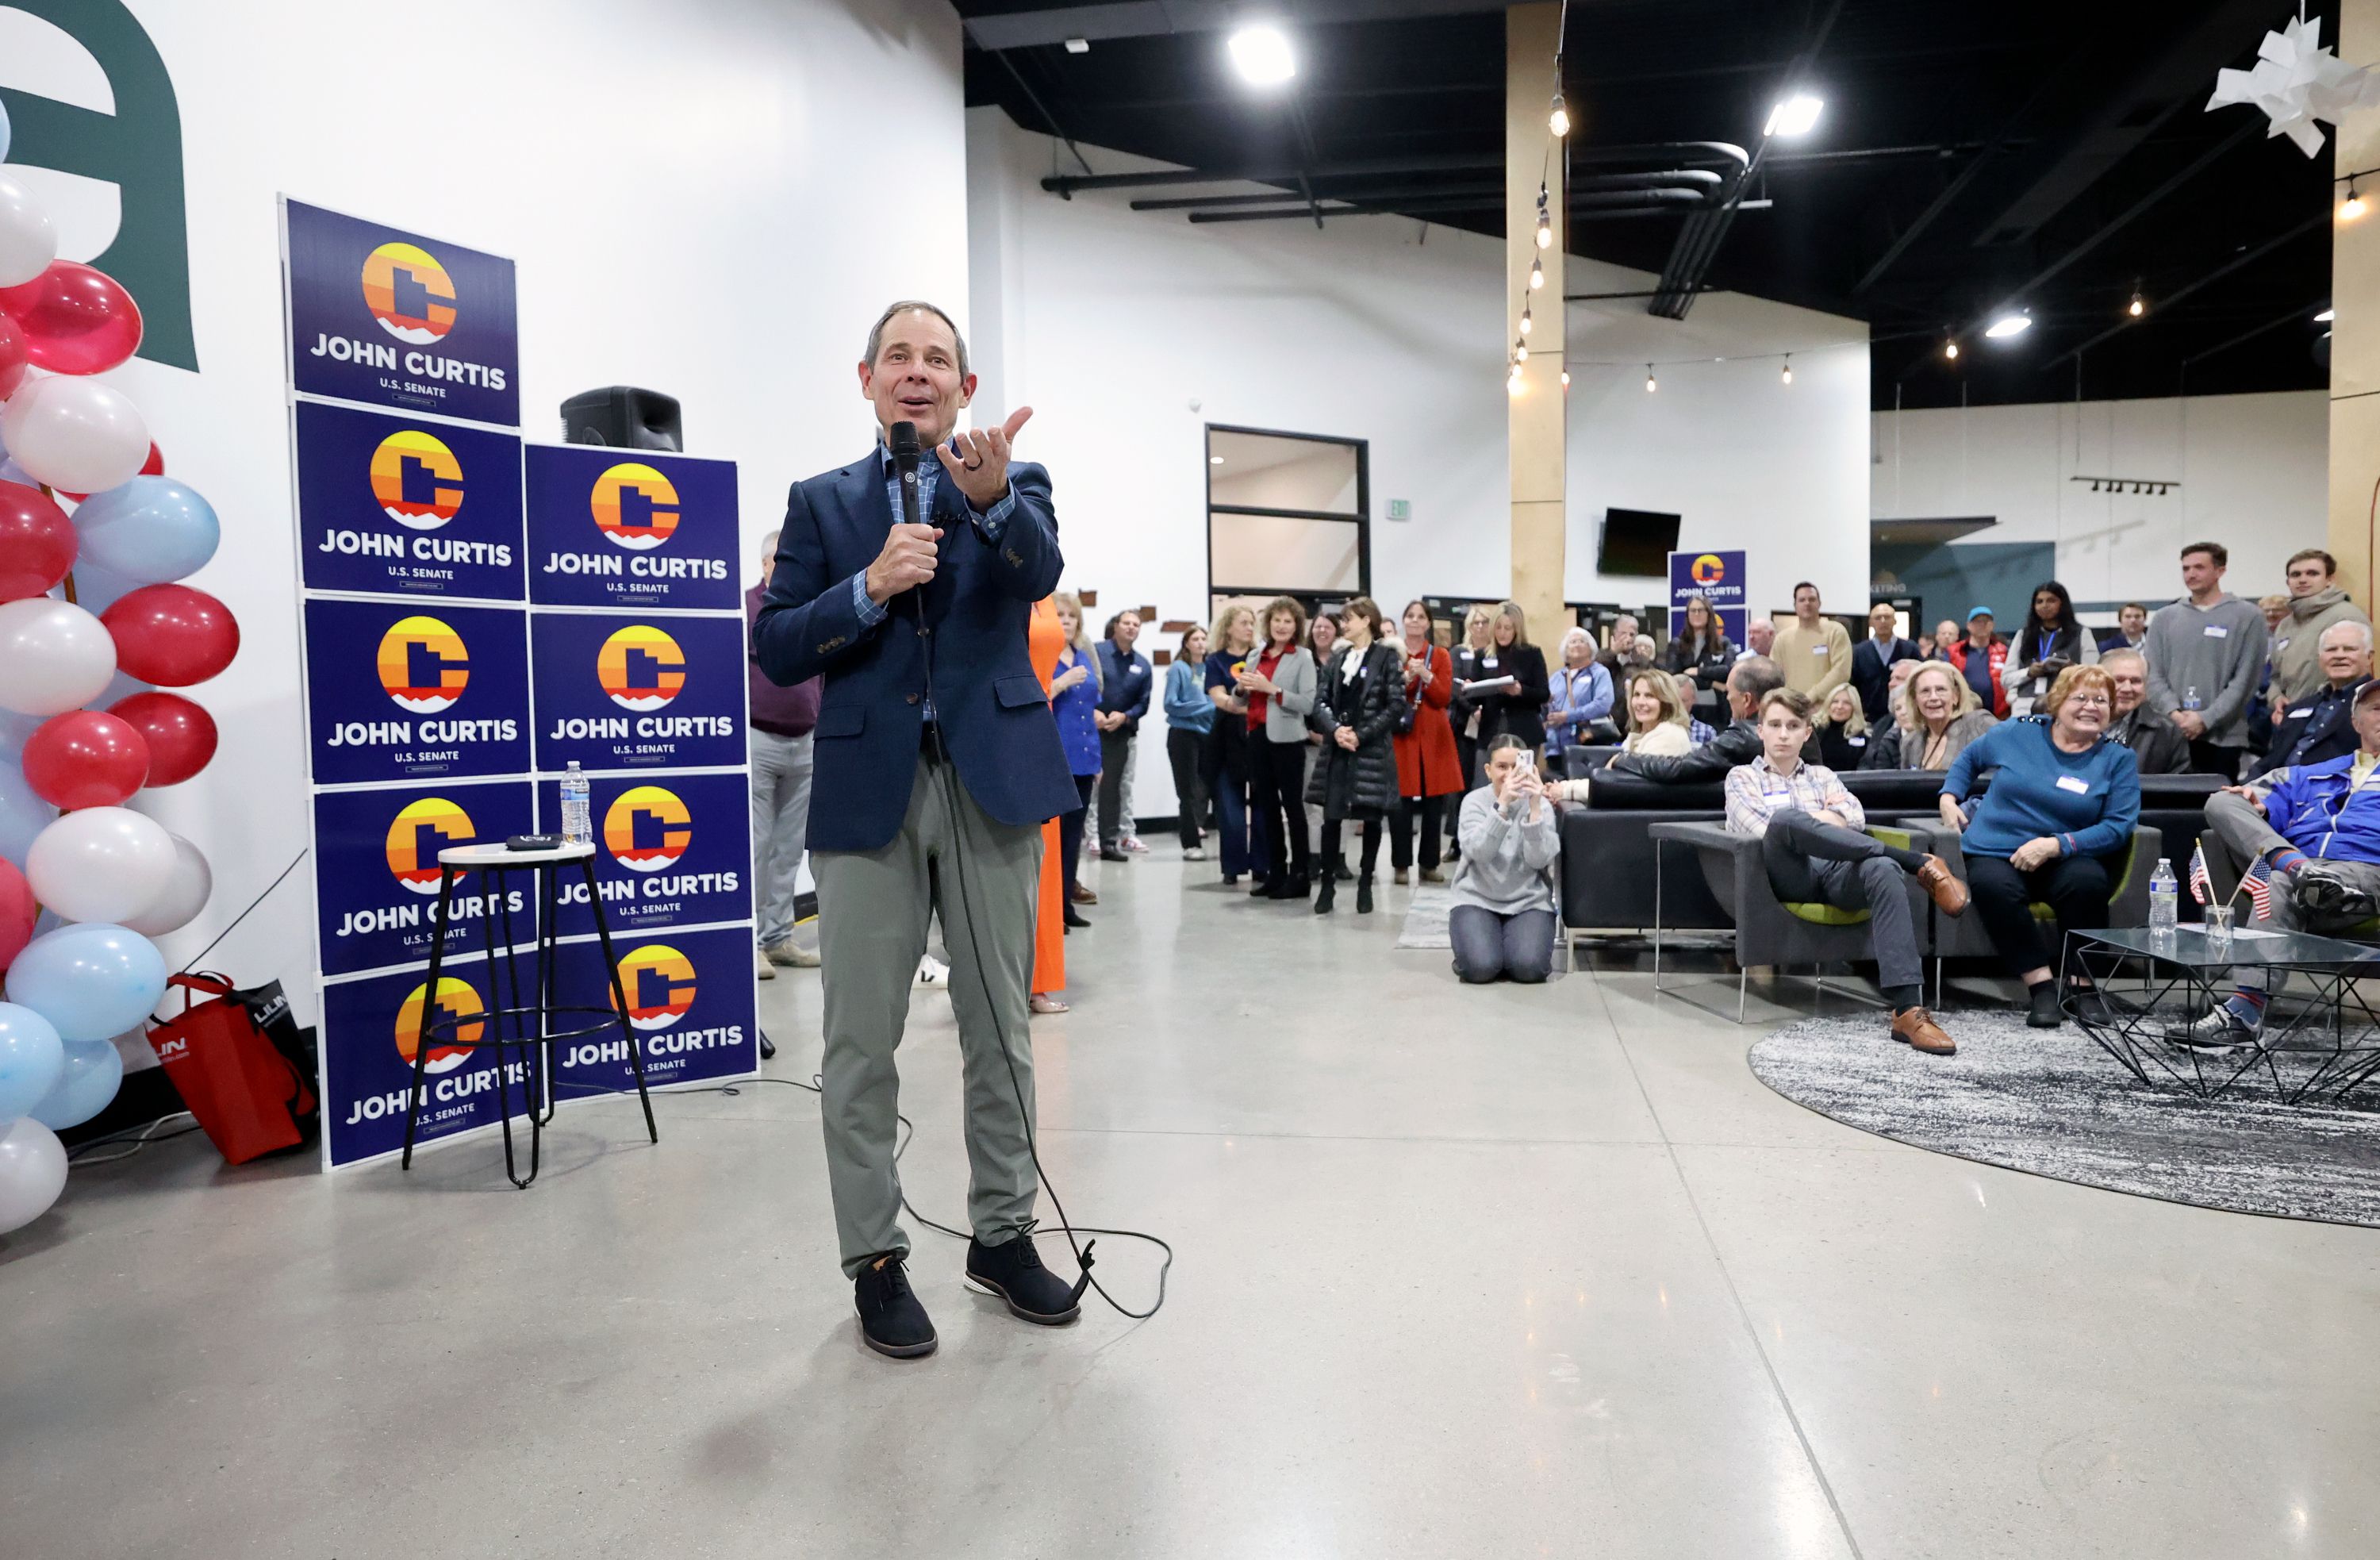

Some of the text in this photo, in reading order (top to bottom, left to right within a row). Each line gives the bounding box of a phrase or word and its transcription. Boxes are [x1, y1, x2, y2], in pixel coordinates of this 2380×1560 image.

[310, 333, 506, 390] JOHN CURTIS
[380, 377, 446, 398] U.S. SENATE
[319, 529, 512, 567] JOHN CURTIS
[388, 566, 454, 580] U.S. SENATE
[543, 552, 728, 580] JOHN CURTIS
[606, 582, 669, 594] U.S. SENATE
[1675, 586, 1741, 598] JOHN CURTIS
[328, 719, 518, 747] JOHN CURTIS
[550, 716, 734, 740] JOHN CURTIS
[394, 751, 459, 763] U.S. SENATE
[613, 743, 675, 755] U.S. SENATE
[557, 871, 739, 905] JOHN CURTIS
[336, 890, 524, 937] JOHN CURTS
[620, 902, 681, 916] U.S. SENATE
[403, 934, 424, 946] U.S.
[562, 1025, 743, 1069] JOHN CURTIS
[647, 1059, 686, 1072] SENATE
[345, 1060, 532, 1125] JOHN CURTIS
[436, 1102, 475, 1121] SENATE
